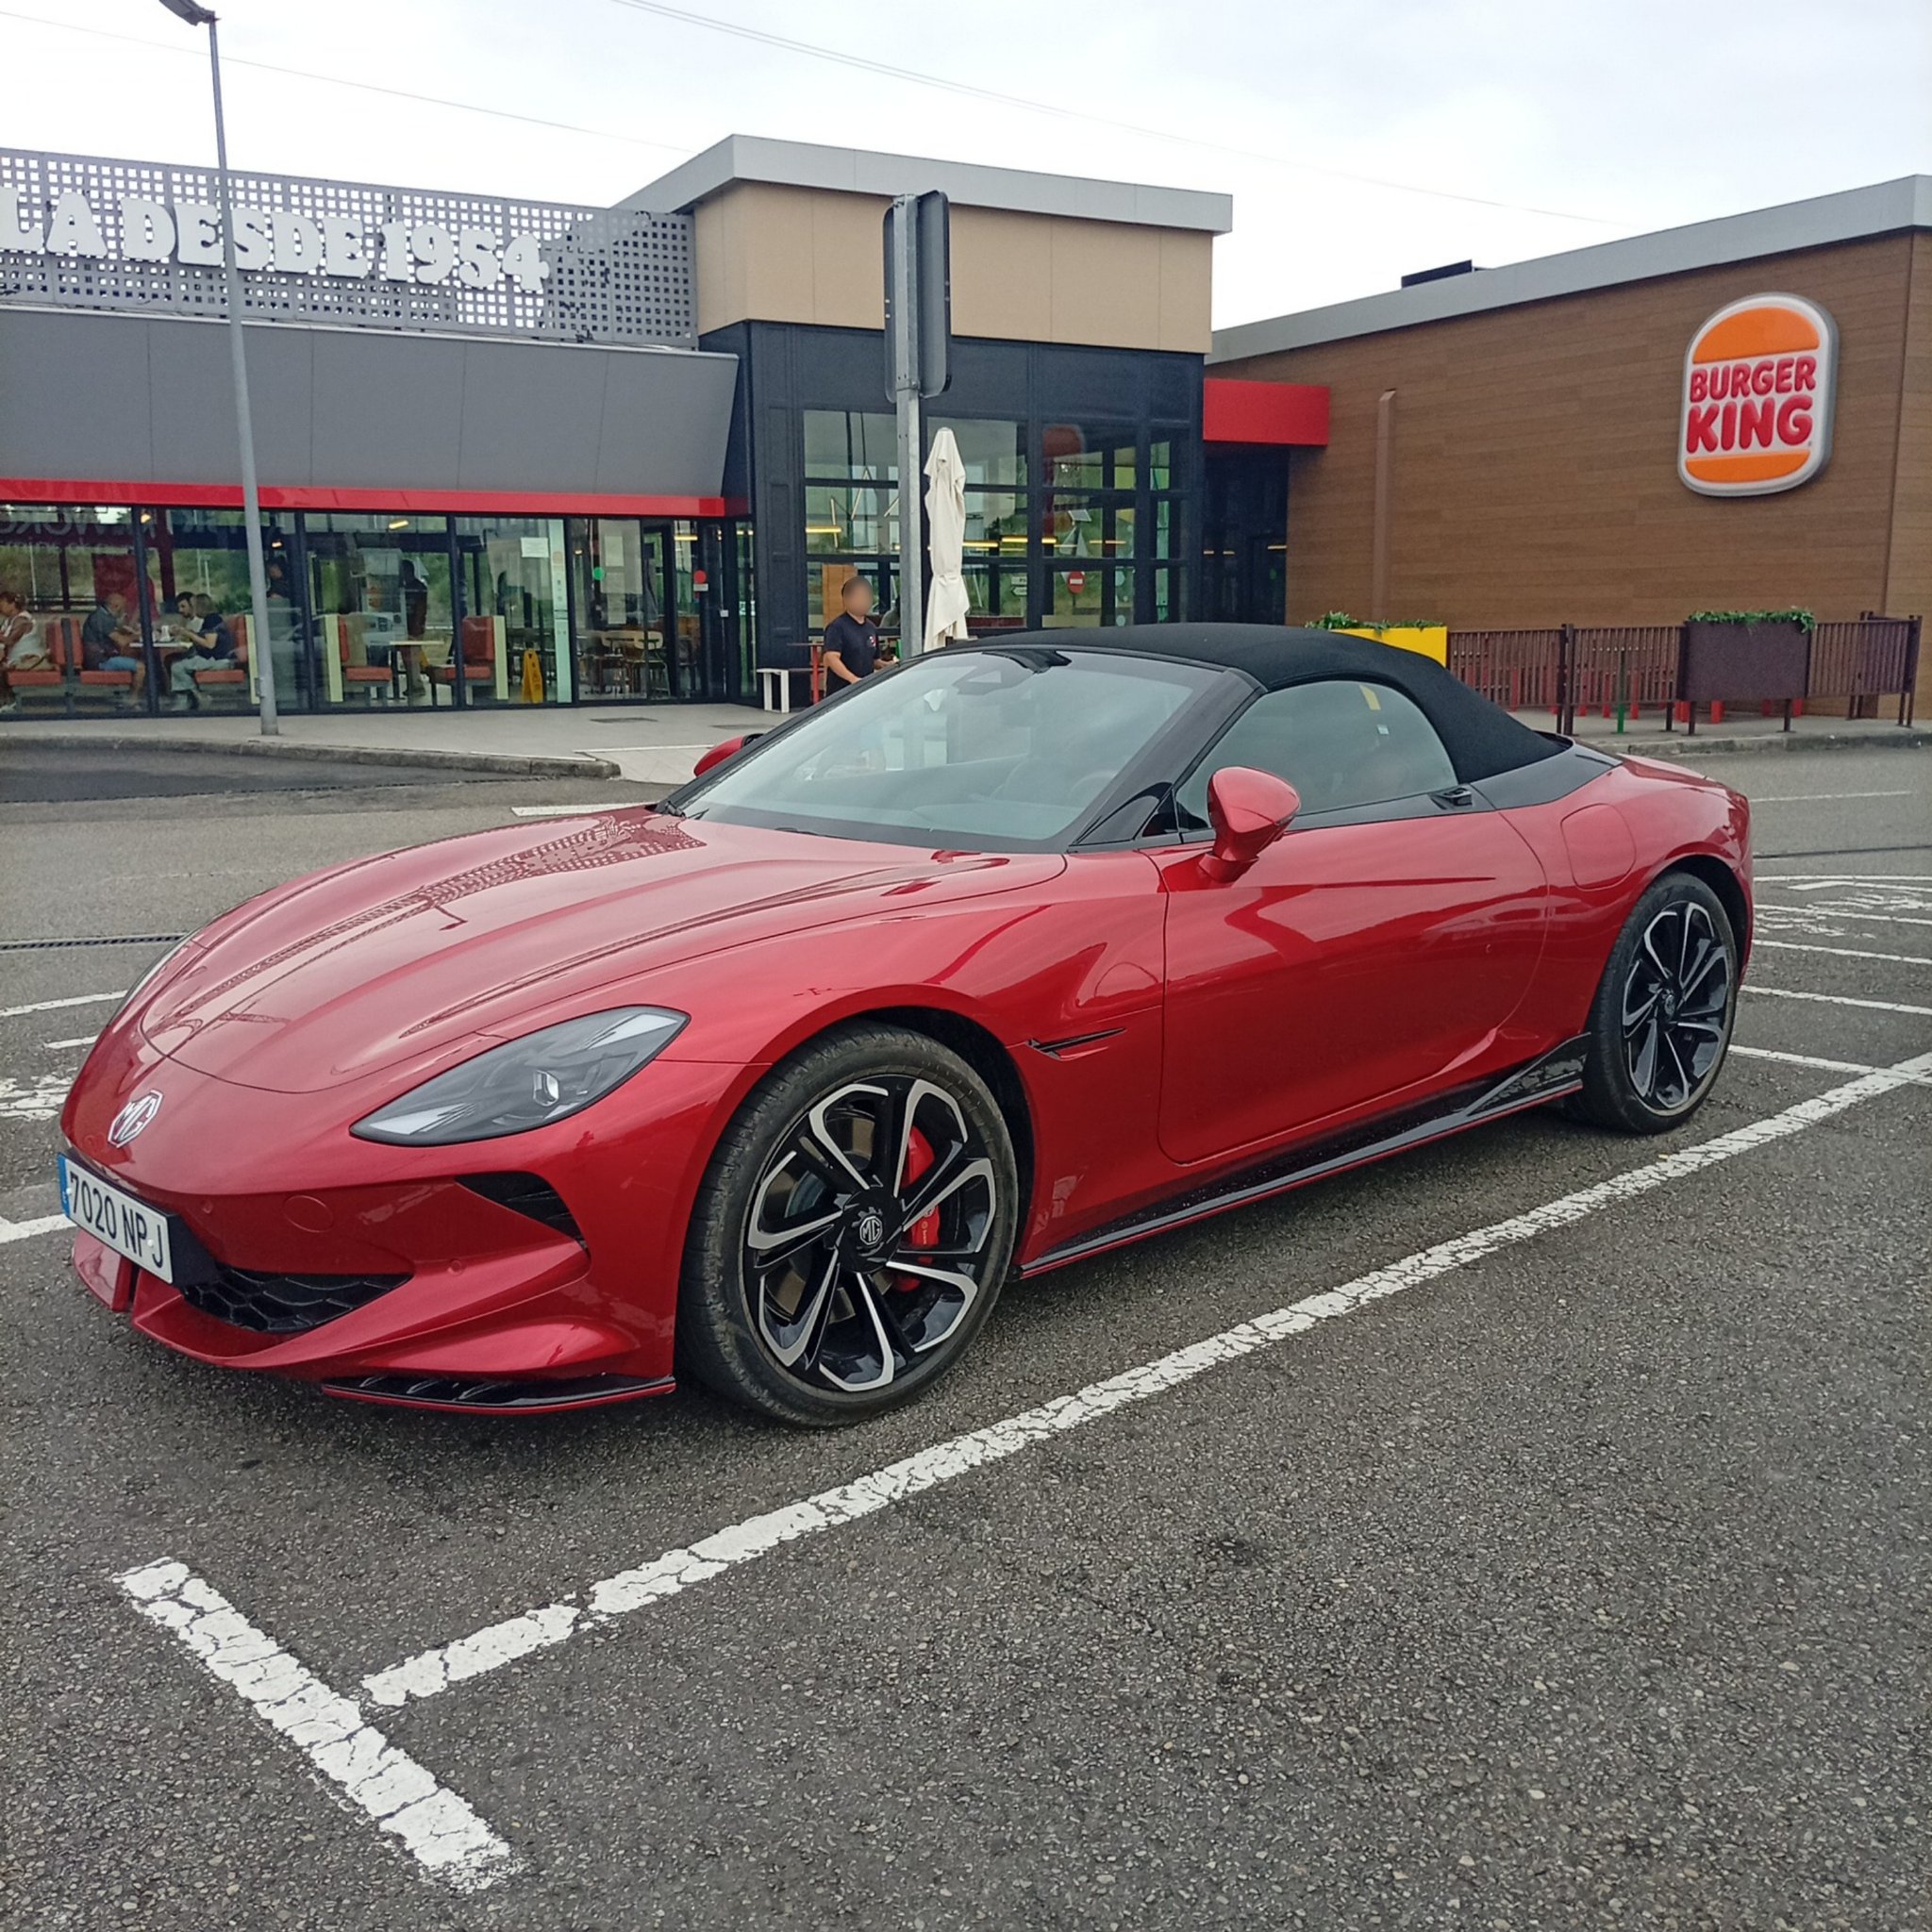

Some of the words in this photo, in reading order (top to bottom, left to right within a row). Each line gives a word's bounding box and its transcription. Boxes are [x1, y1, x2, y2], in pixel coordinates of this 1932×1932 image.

[120, 195, 369, 278] DESDE
[381, 221, 550, 291] 1954
[1690, 356, 1817, 403] BURGER
[1686, 394, 1813, 454] KING
[112, 1093, 159, 1142] MG
[70, 1170, 118, 1241] 7020
[121, 1204, 164, 1269] NPJ
[861, 1219, 880, 1242] MG
